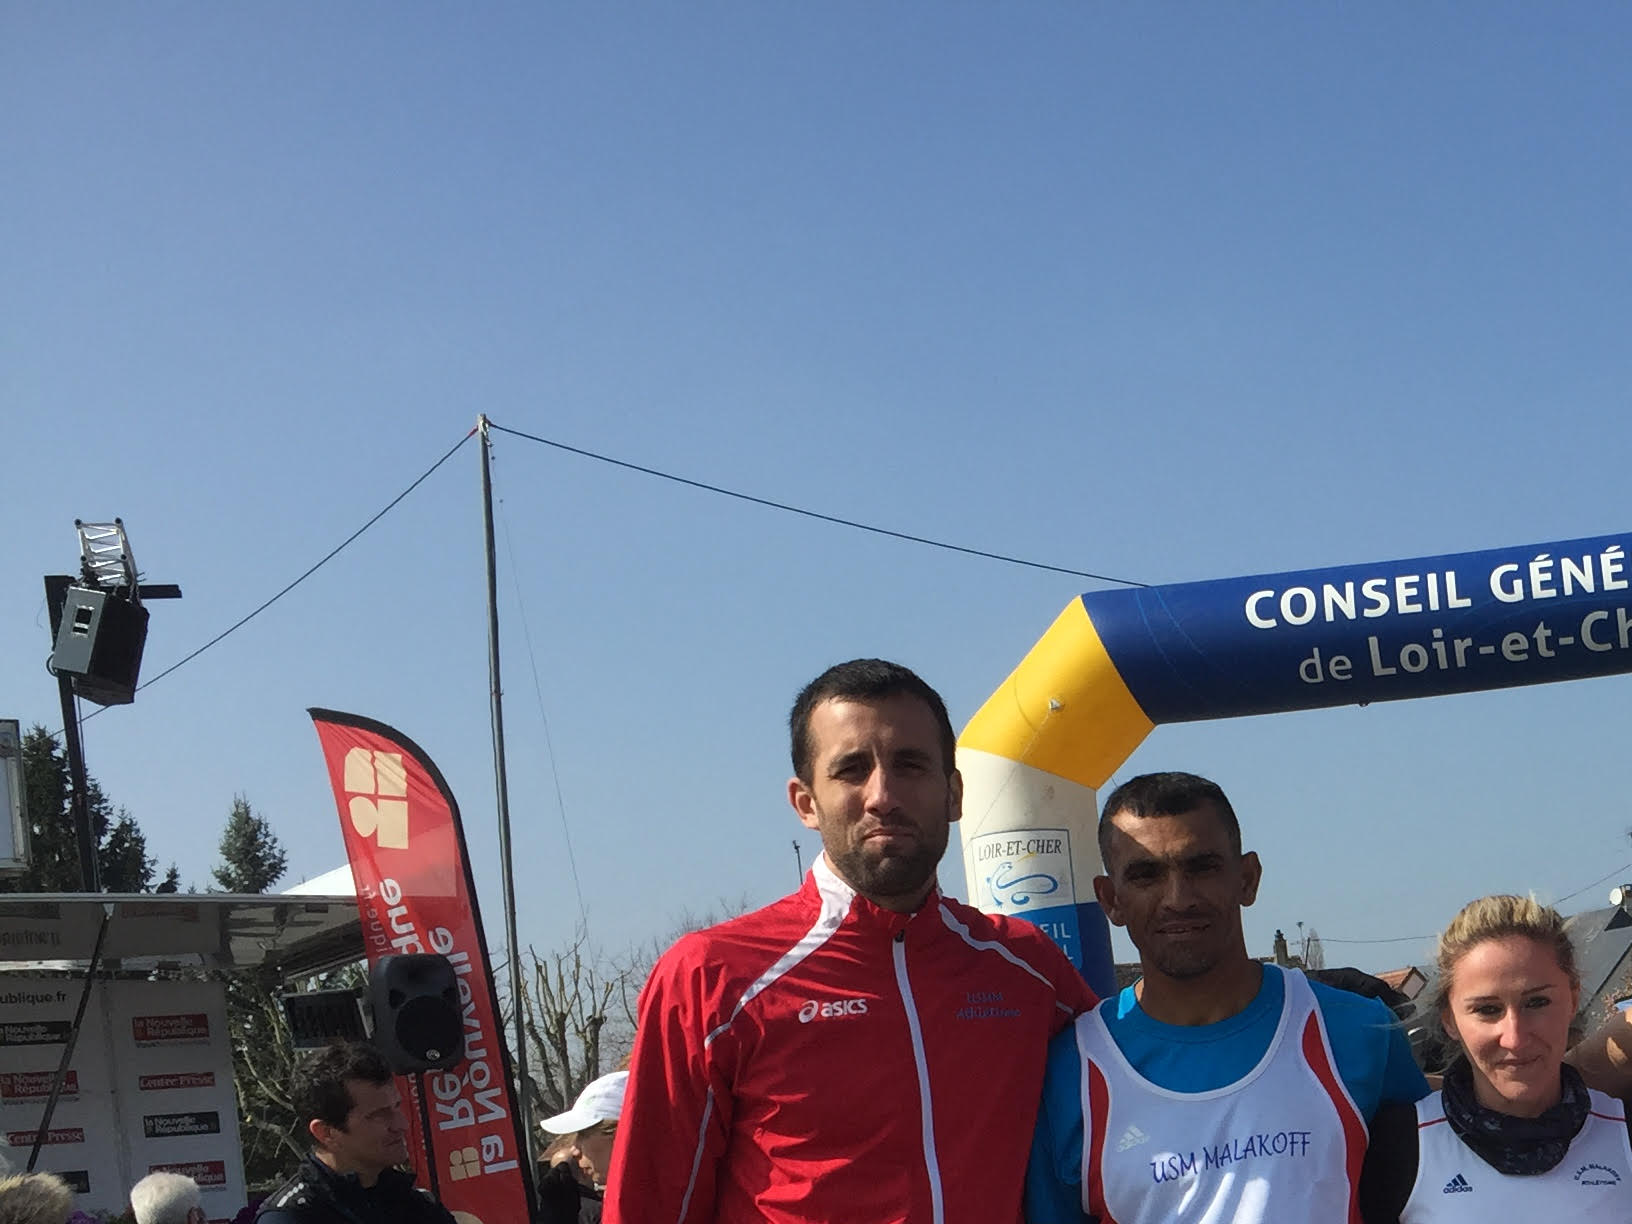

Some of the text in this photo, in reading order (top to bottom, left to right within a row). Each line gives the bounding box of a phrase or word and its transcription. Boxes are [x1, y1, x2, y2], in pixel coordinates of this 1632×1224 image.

[1244, 570, 1473, 630] CONSEIL
[1298, 647, 1353, 684] de
[978, 838, 1062, 862] LOIR-ET-CHER
[820, 999, 869, 1018] asics
[1150, 1131, 1312, 1184] USM MALAKOFF
[1442, 1185, 1473, 1194] adidas
